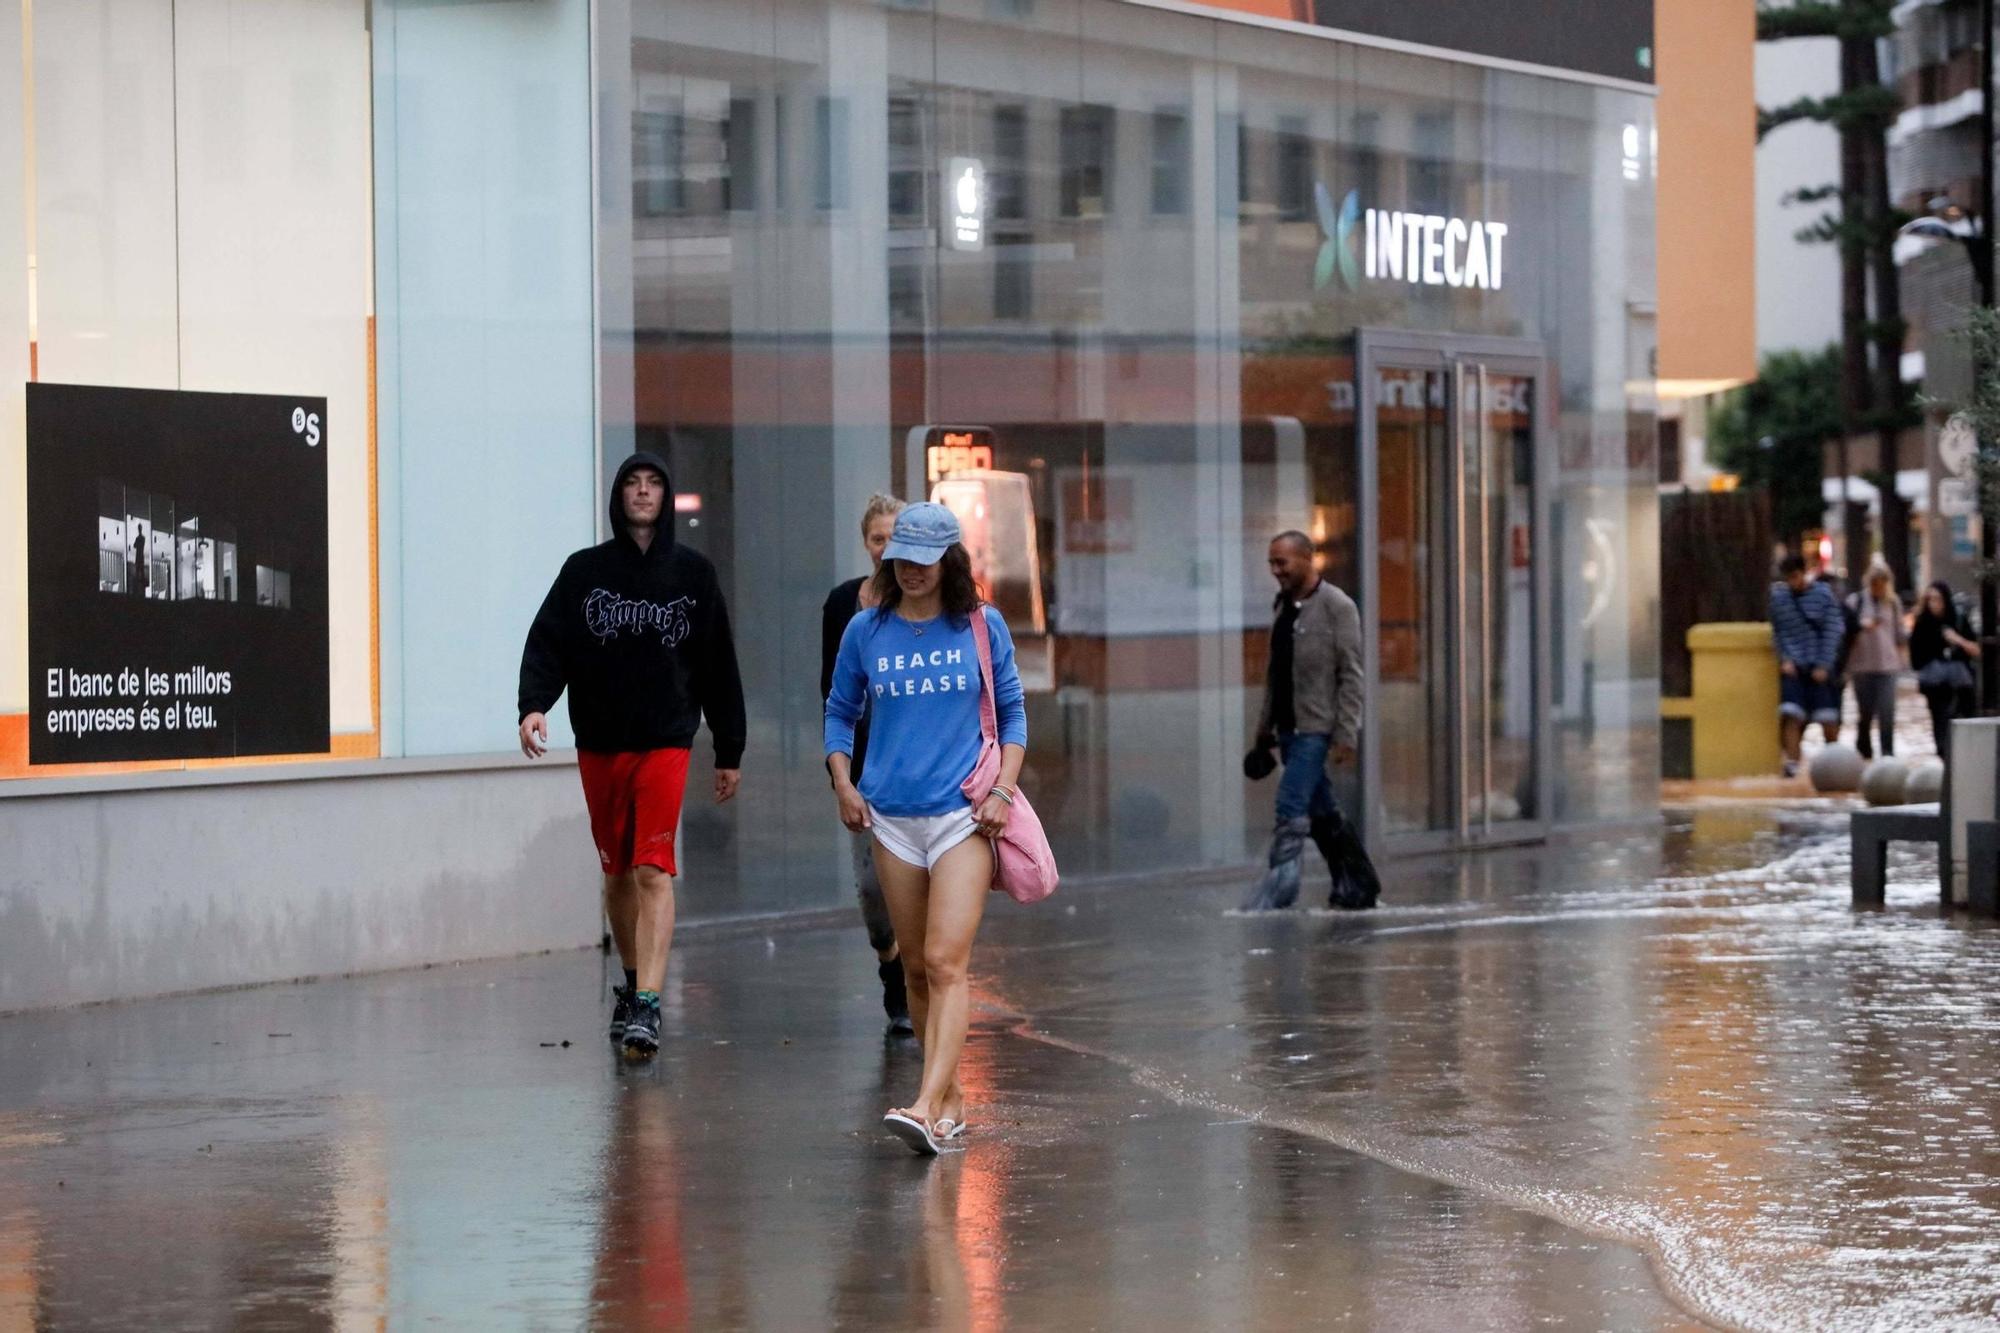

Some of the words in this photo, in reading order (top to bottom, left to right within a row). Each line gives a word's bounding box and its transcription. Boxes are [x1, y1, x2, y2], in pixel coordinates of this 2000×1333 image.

[1365, 208, 1508, 290] INTECAT
[877, 649, 961, 672] BEACH
[47, 668, 63, 698] El
[69, 668, 113, 698] banc
[117, 666, 140, 696] de
[144, 667, 169, 696] les
[174, 665, 232, 695] millors
[875, 675, 967, 698] PLEASE
[47, 707, 135, 739] empreses
[139, 700, 161, 731] és
[165, 700, 180, 730] el
[185, 701, 218, 729] teu.
